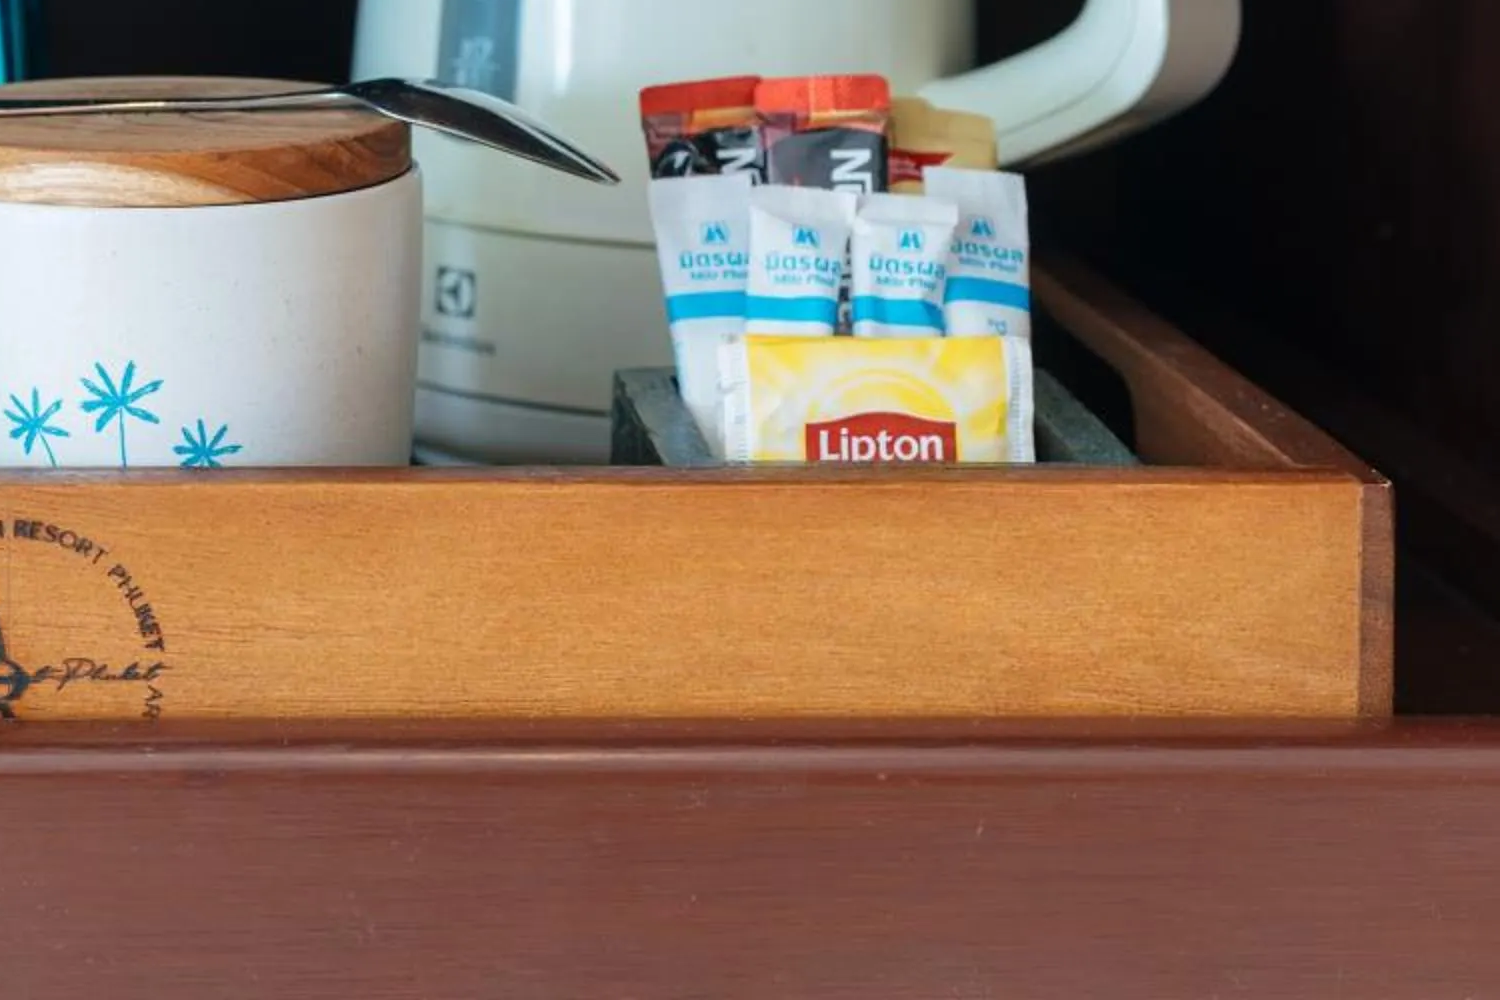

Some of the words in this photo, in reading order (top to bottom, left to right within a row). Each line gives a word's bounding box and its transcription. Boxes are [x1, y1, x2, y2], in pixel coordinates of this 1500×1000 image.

[819, 427, 944, 461] Lipton
[14, 520, 109, 564] RESORT
[107, 564, 165, 652] PHUKET
